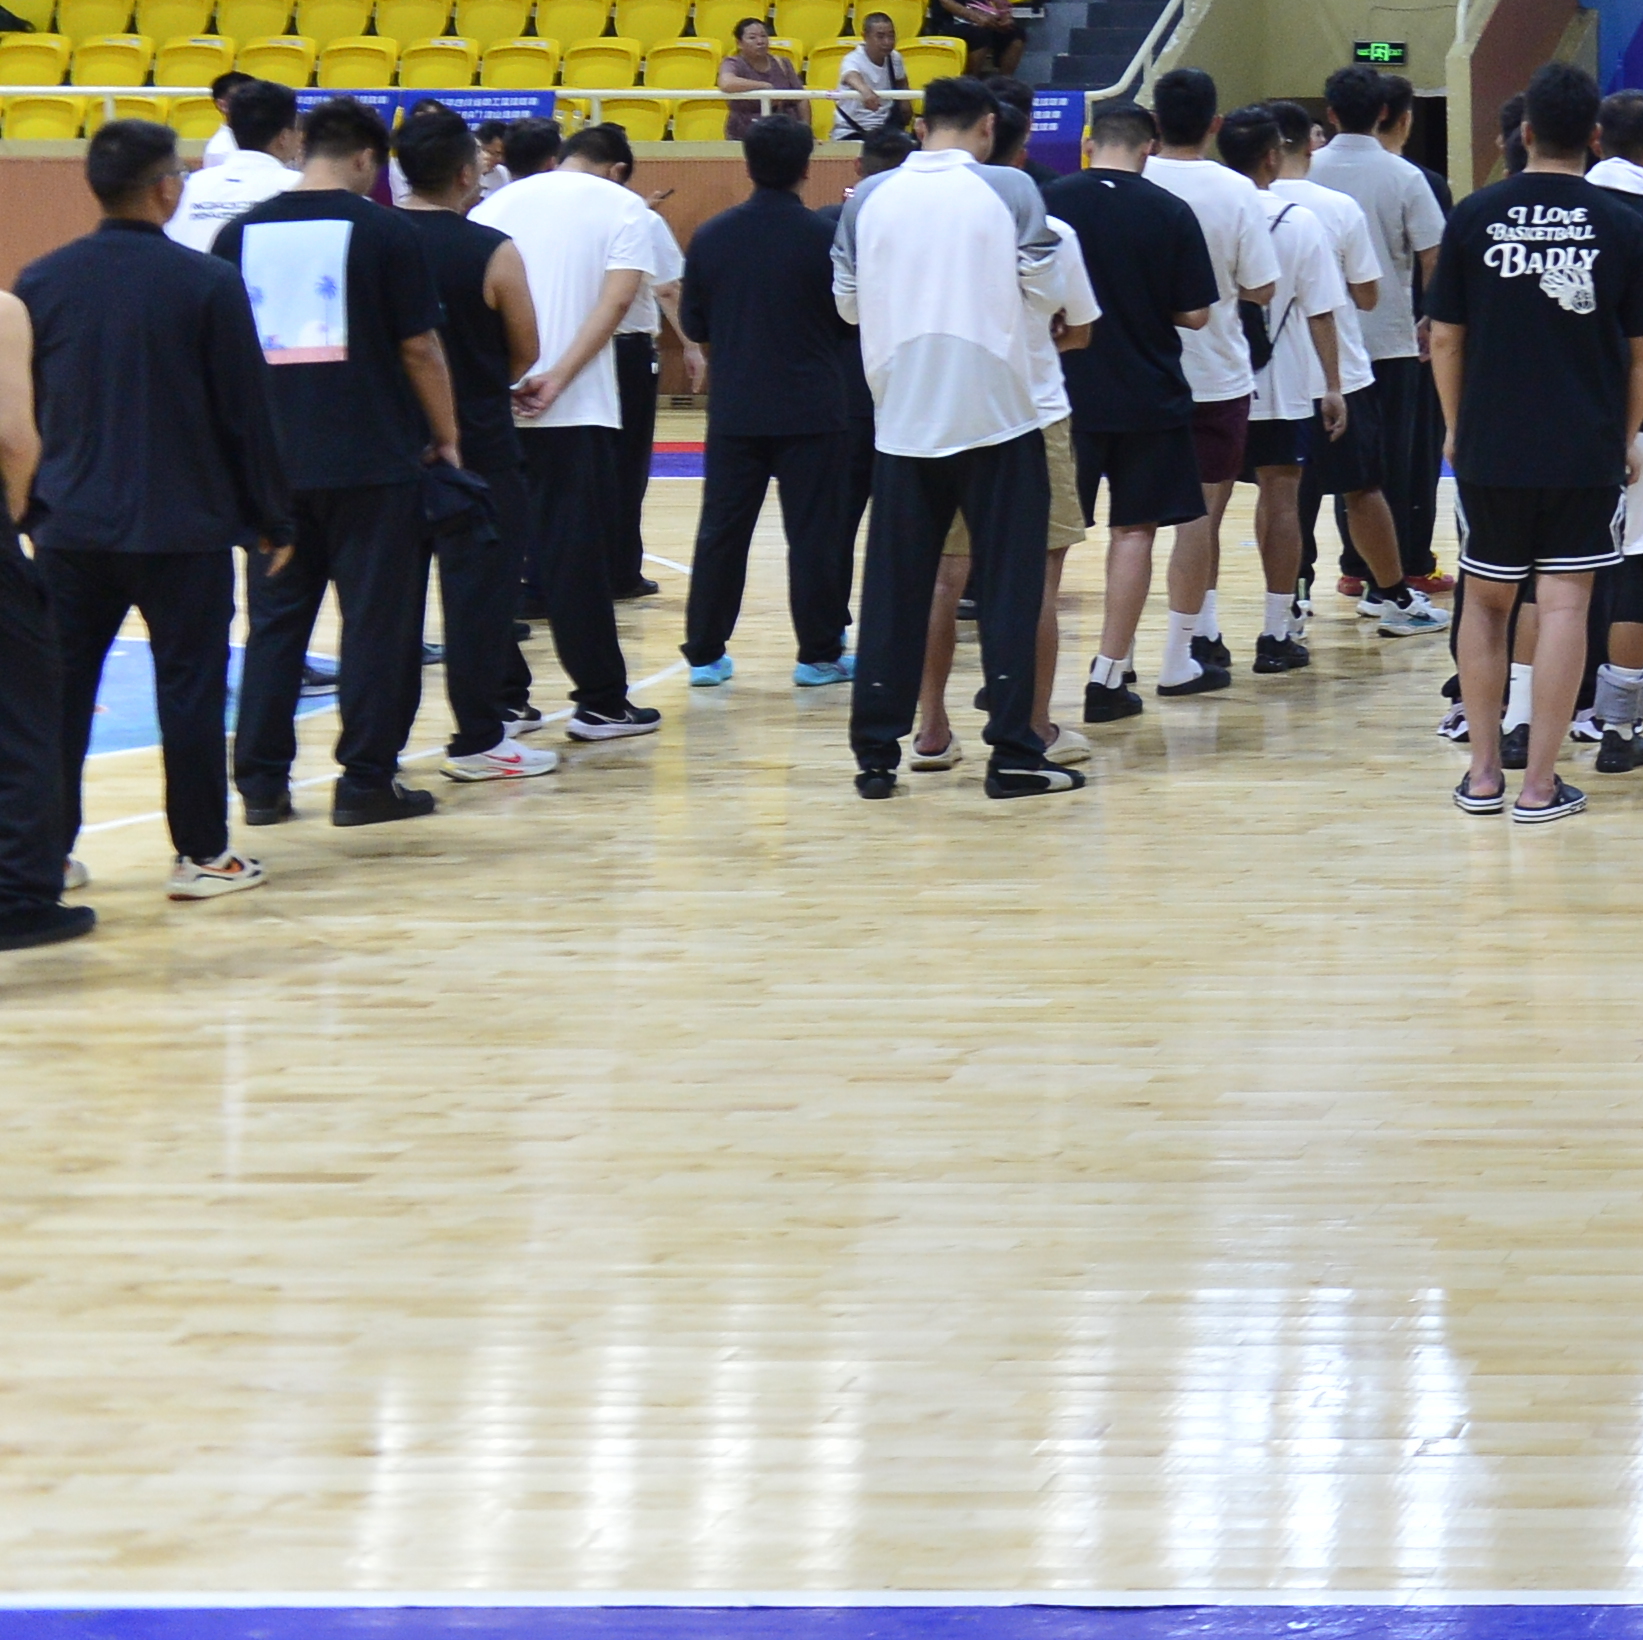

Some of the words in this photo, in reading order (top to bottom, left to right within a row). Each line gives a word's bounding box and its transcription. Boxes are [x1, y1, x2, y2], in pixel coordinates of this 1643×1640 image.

[1507, 206, 1528, 225] I
[1531, 204, 1588, 225] LOVE
[1486, 222, 1596, 242] BASKETBALL
[1483, 242, 1600, 278] BADLY
